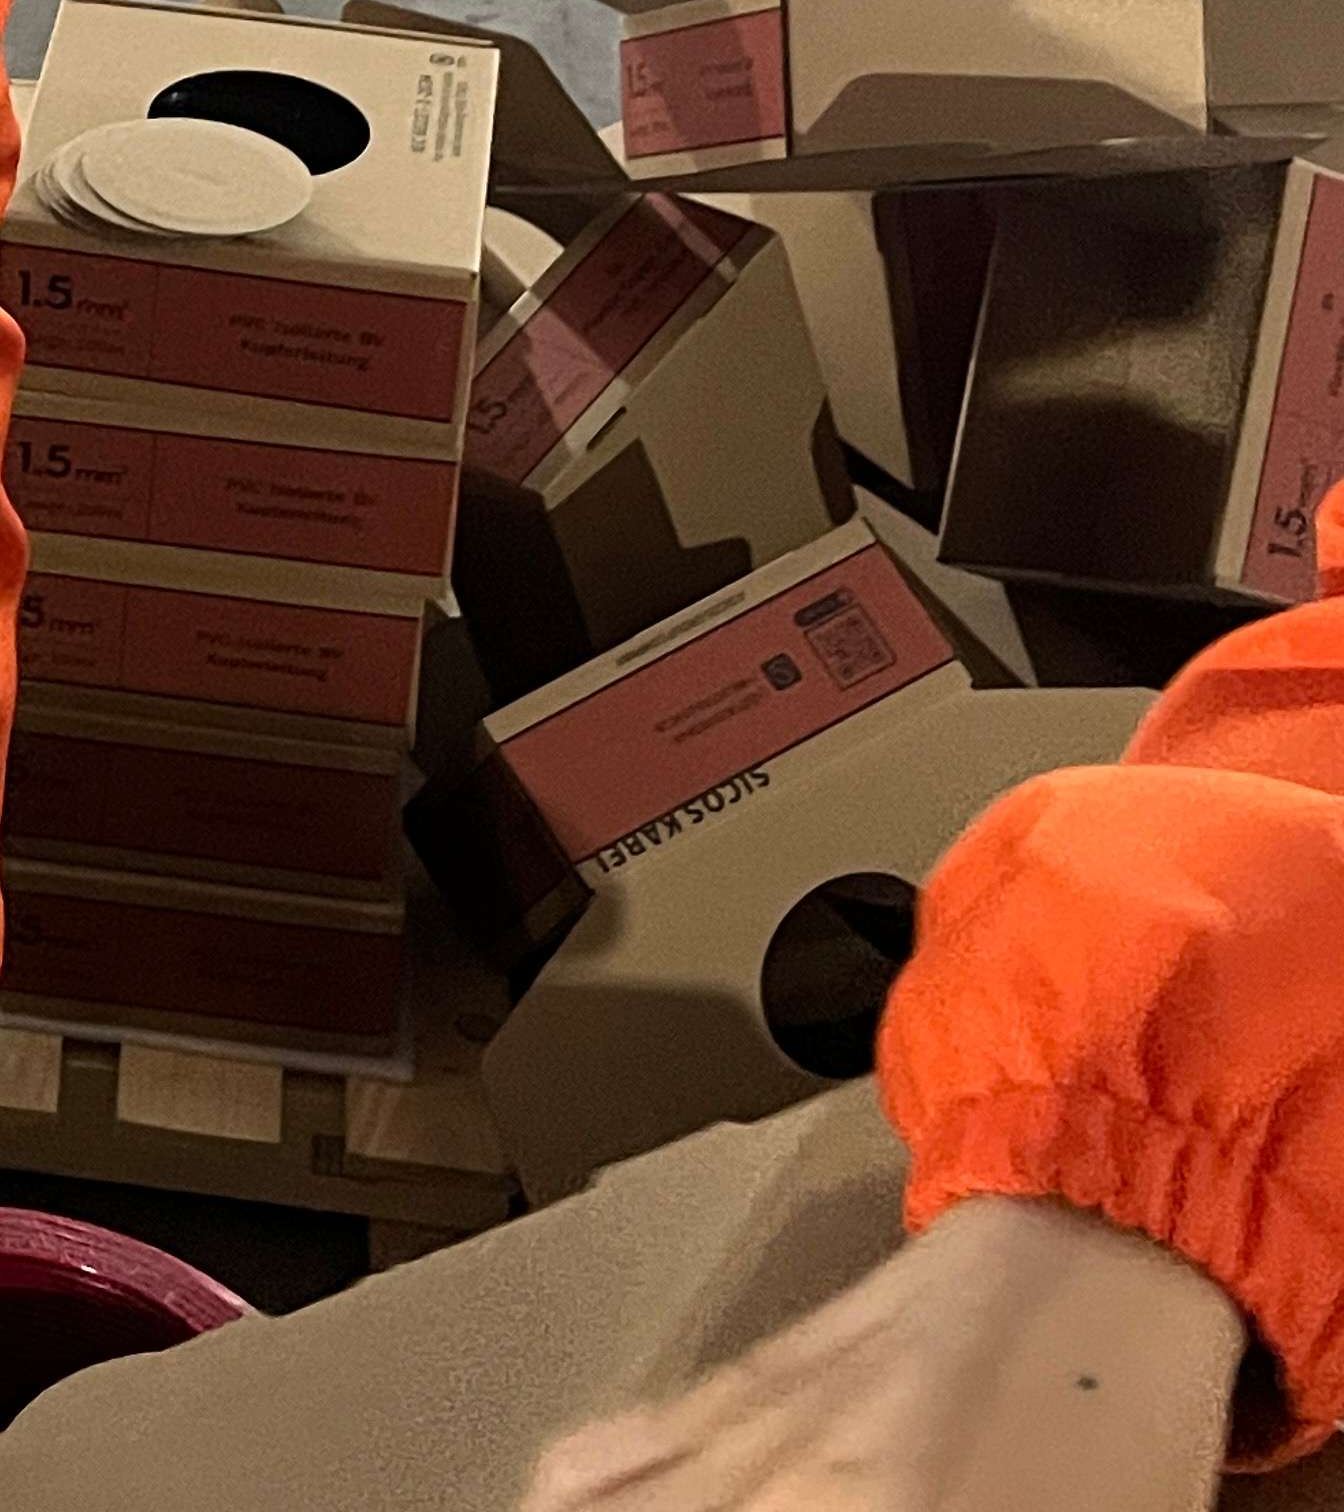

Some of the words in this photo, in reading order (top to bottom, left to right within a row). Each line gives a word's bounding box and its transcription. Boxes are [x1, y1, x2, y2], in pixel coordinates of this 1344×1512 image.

[18, 269, 72, 310] 1.5
[18, 440, 72, 479] 1.5
[1268, 504, 1309, 559] 1.5
[684, 768, 770, 825] SICOS
[596, 814, 683, 874] KABEL
